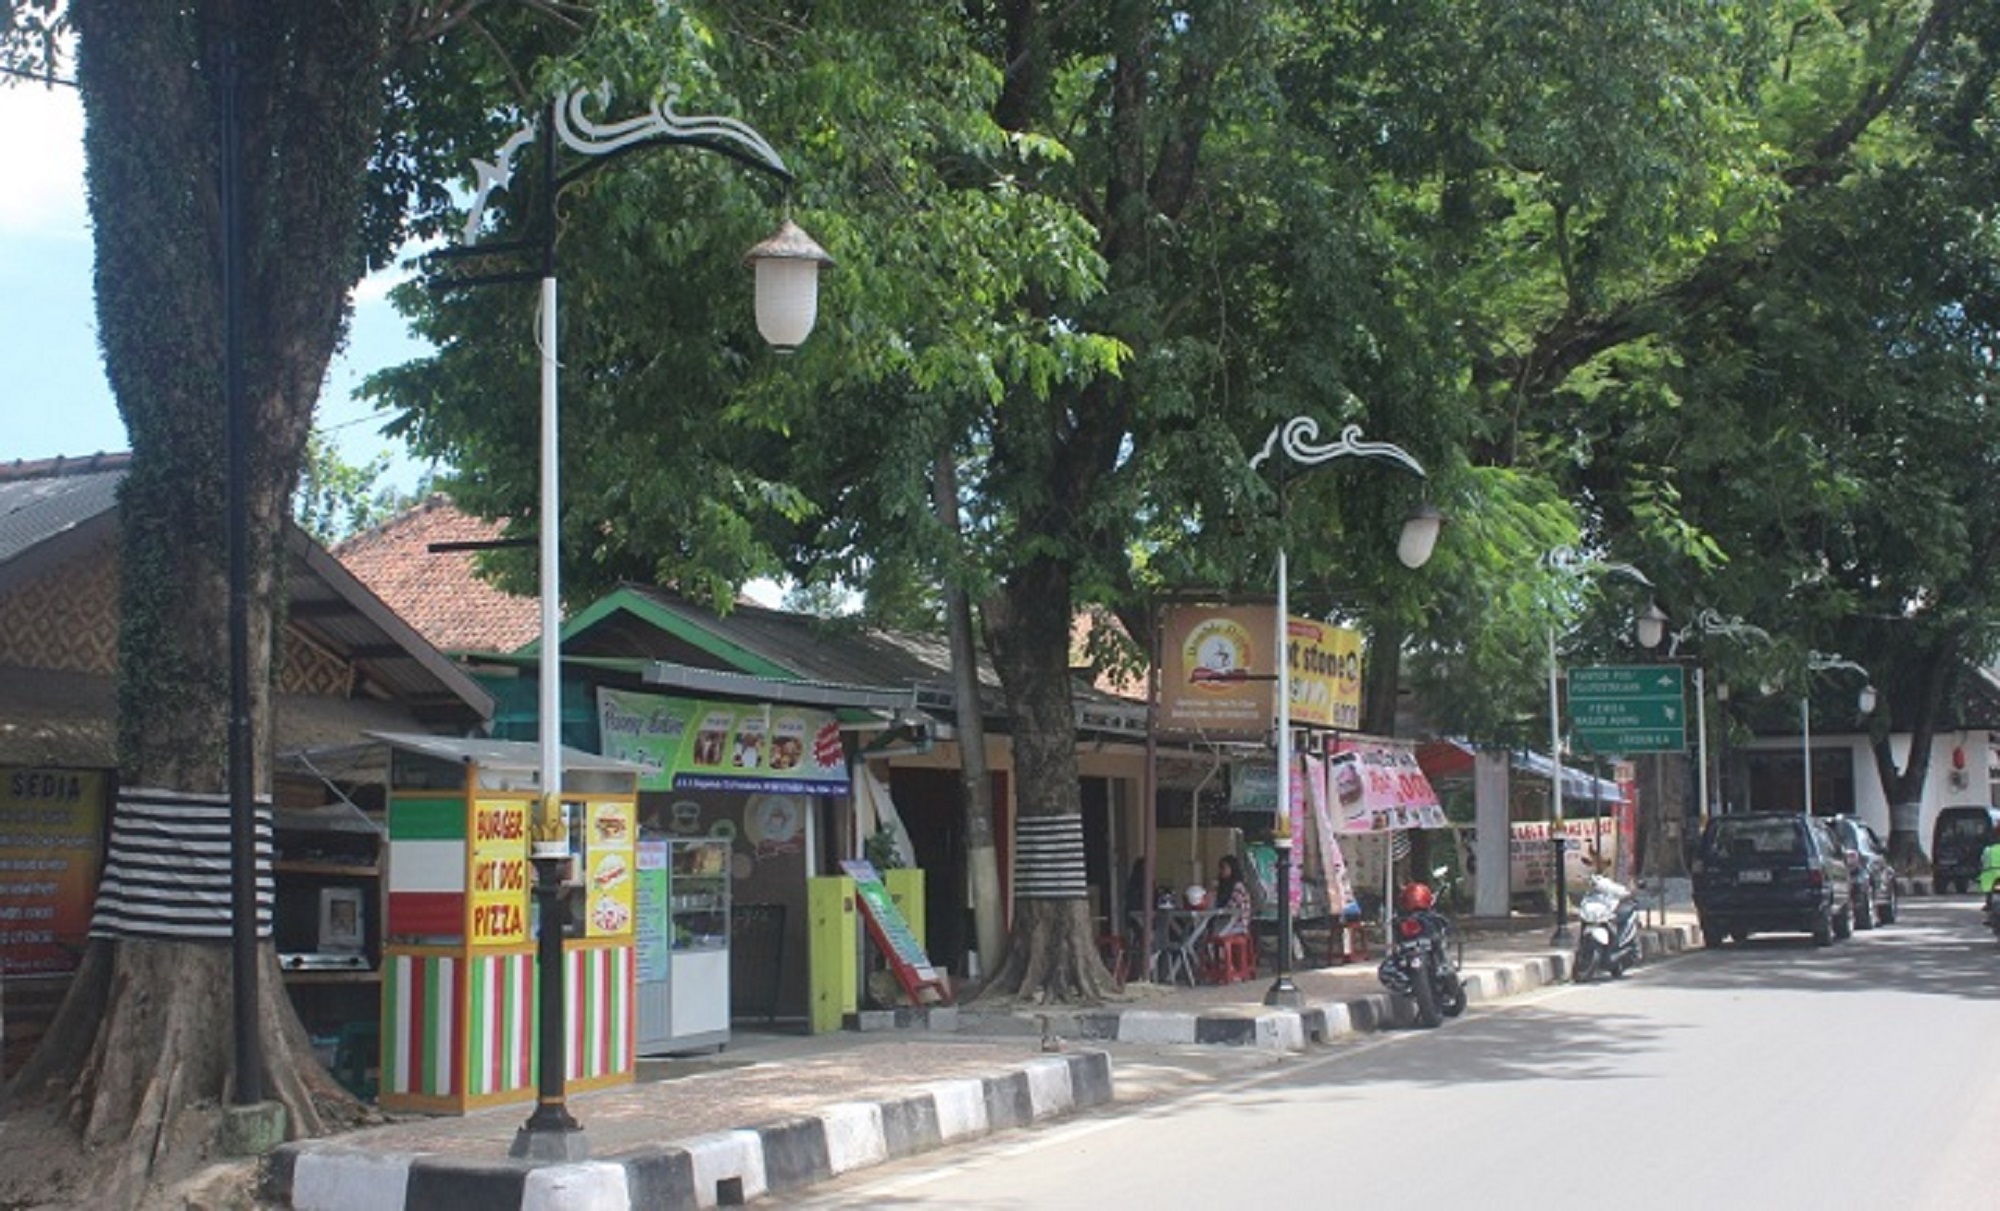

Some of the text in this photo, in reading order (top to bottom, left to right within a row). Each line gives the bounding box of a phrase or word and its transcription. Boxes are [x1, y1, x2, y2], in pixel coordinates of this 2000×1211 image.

[12, 774, 81, 801] SEDIA
[476, 809, 523, 842] BURGER
[475, 860, 523, 891] HOT DOG
[474, 904, 522, 936] PIZZA
